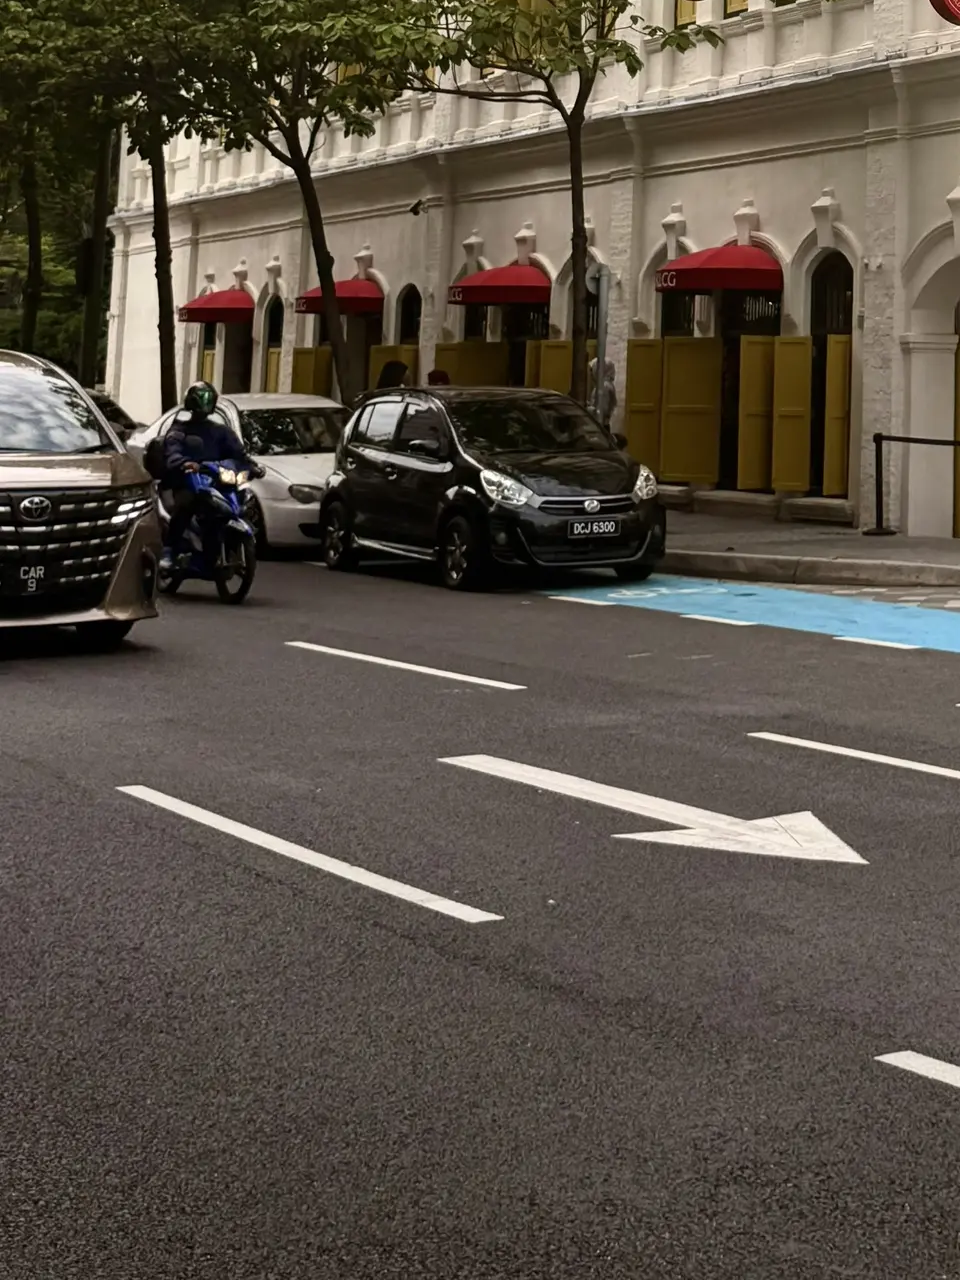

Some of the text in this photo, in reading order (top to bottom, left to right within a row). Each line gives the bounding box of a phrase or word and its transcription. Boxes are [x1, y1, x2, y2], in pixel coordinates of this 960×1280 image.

[573, 521, 616, 535] DCJ 6300
[20, 565, 45, 580] CAR
[27, 578, 37, 592] 9
